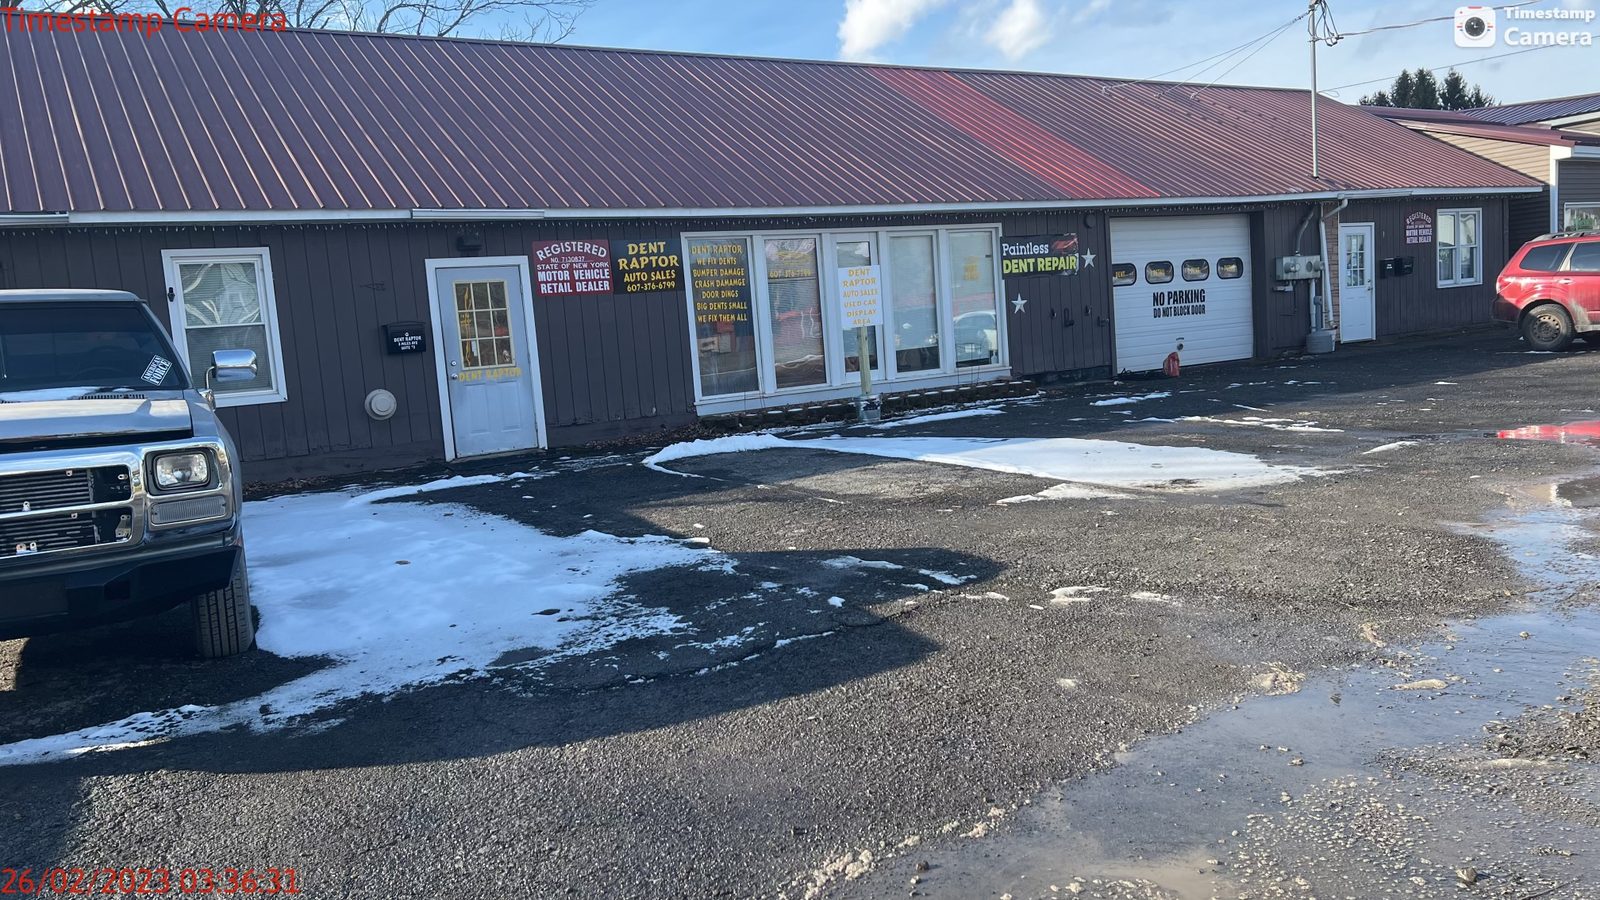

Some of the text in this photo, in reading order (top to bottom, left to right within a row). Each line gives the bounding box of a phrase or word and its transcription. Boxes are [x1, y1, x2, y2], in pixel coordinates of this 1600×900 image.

[536, 241, 607, 260] REGISTERED
[627, 241, 666, 255] DENT
[691, 244, 743, 254] DENT RAPTOR
[1002, 242, 1049, 256] Paintless
[618, 255, 679, 270] RAPTOR
[696, 256, 737, 265] WE FIX DENTS
[1003, 256, 1077, 274] DENT REPAIR
[537, 268, 610, 282] MOTOR VEHICLE
[623, 269, 676, 283] AUTO SALES
[692, 268, 745, 278] BUMPER DAMAGE
[848, 269, 870, 277] DENT
[540, 280, 610, 294] RETAIL DEALER
[627, 281, 676, 292] 607-376-6799
[694, 280, 715, 288] CRASH
[842, 278, 876, 288] RAPTOR
[702, 290, 739, 299] DOOR DINGS
[843, 288, 878, 298] AUTO SALES
[1152, 289, 1205, 307] NO PARKING
[696, 300, 748, 310] BIG DENTS SMALL
[844, 300, 861, 308] USED
[847, 309, 877, 317] DISPLAY
[1153, 304, 1205, 318] DO NOT BLOCK DOOR
[697, 312, 748, 323] WE FIX THEM ALL
[150, 360, 170, 384] FORCE
[459, 367, 522, 381] DENT RAPTOR
